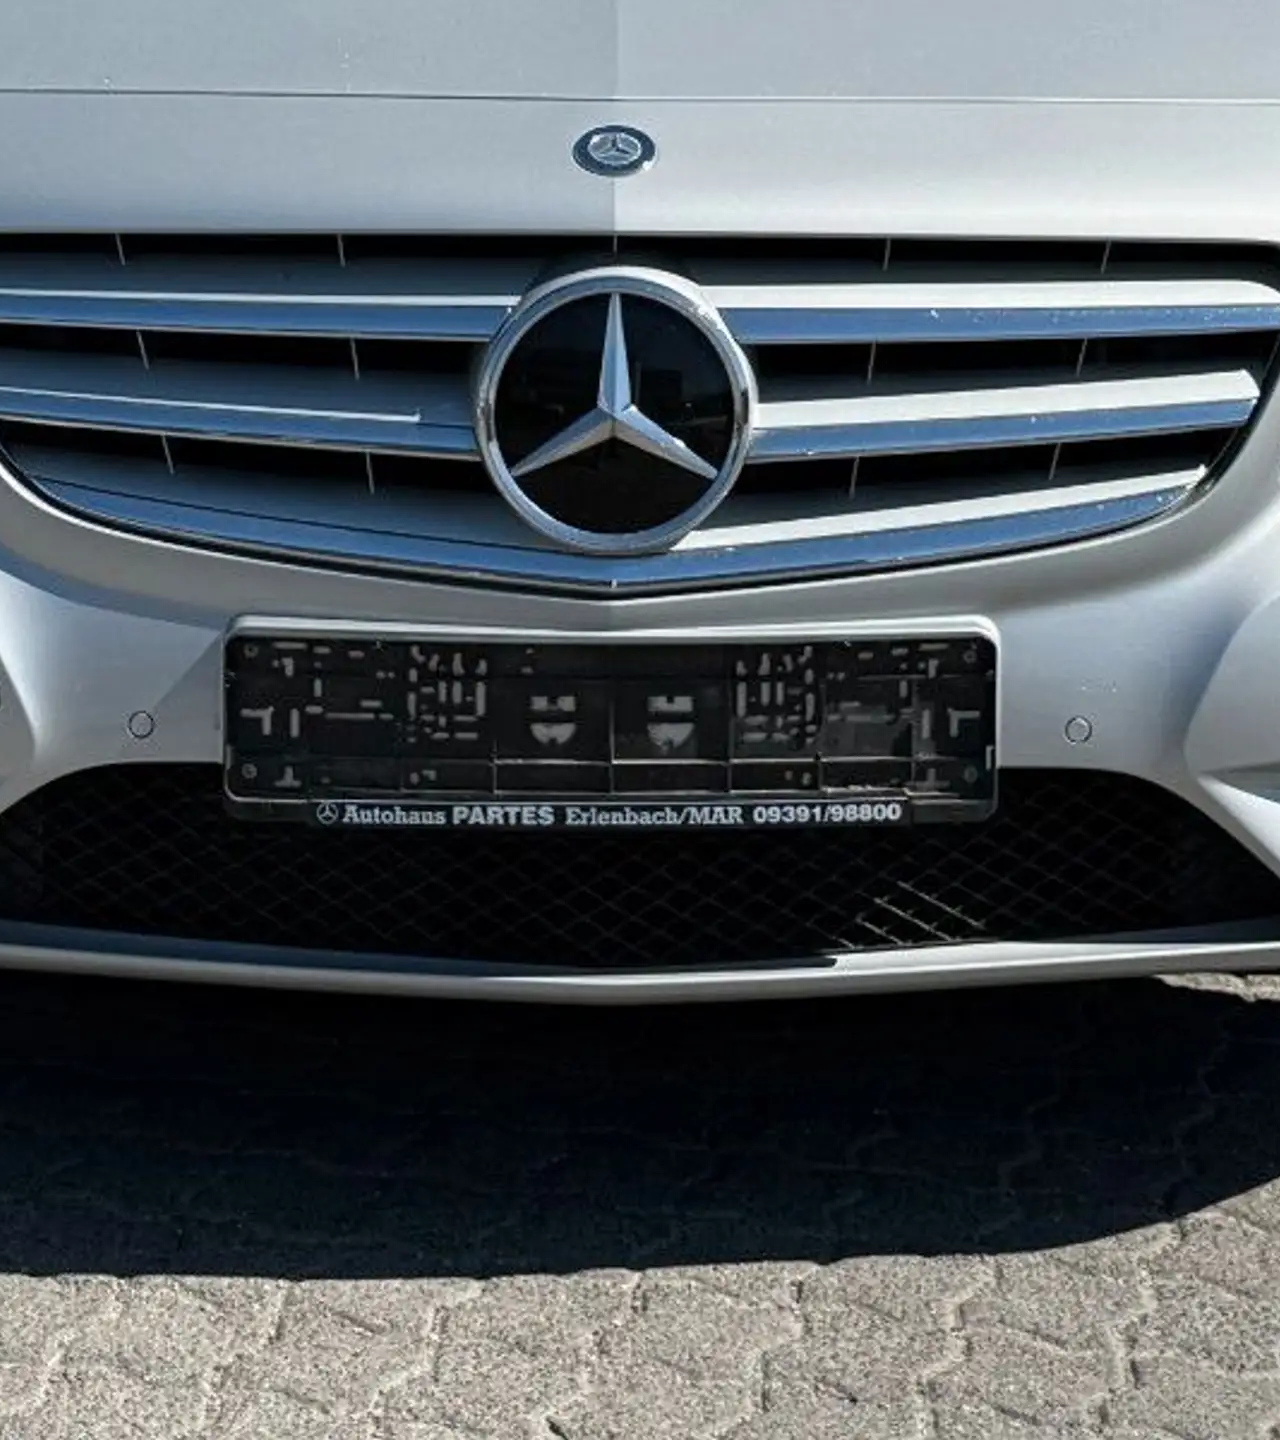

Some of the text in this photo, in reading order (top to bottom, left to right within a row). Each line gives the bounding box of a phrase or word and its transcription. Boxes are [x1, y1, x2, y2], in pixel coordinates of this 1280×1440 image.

[342, 803, 902, 826] Autohaus PARTES Erlenbach/MAR 09391/98800
